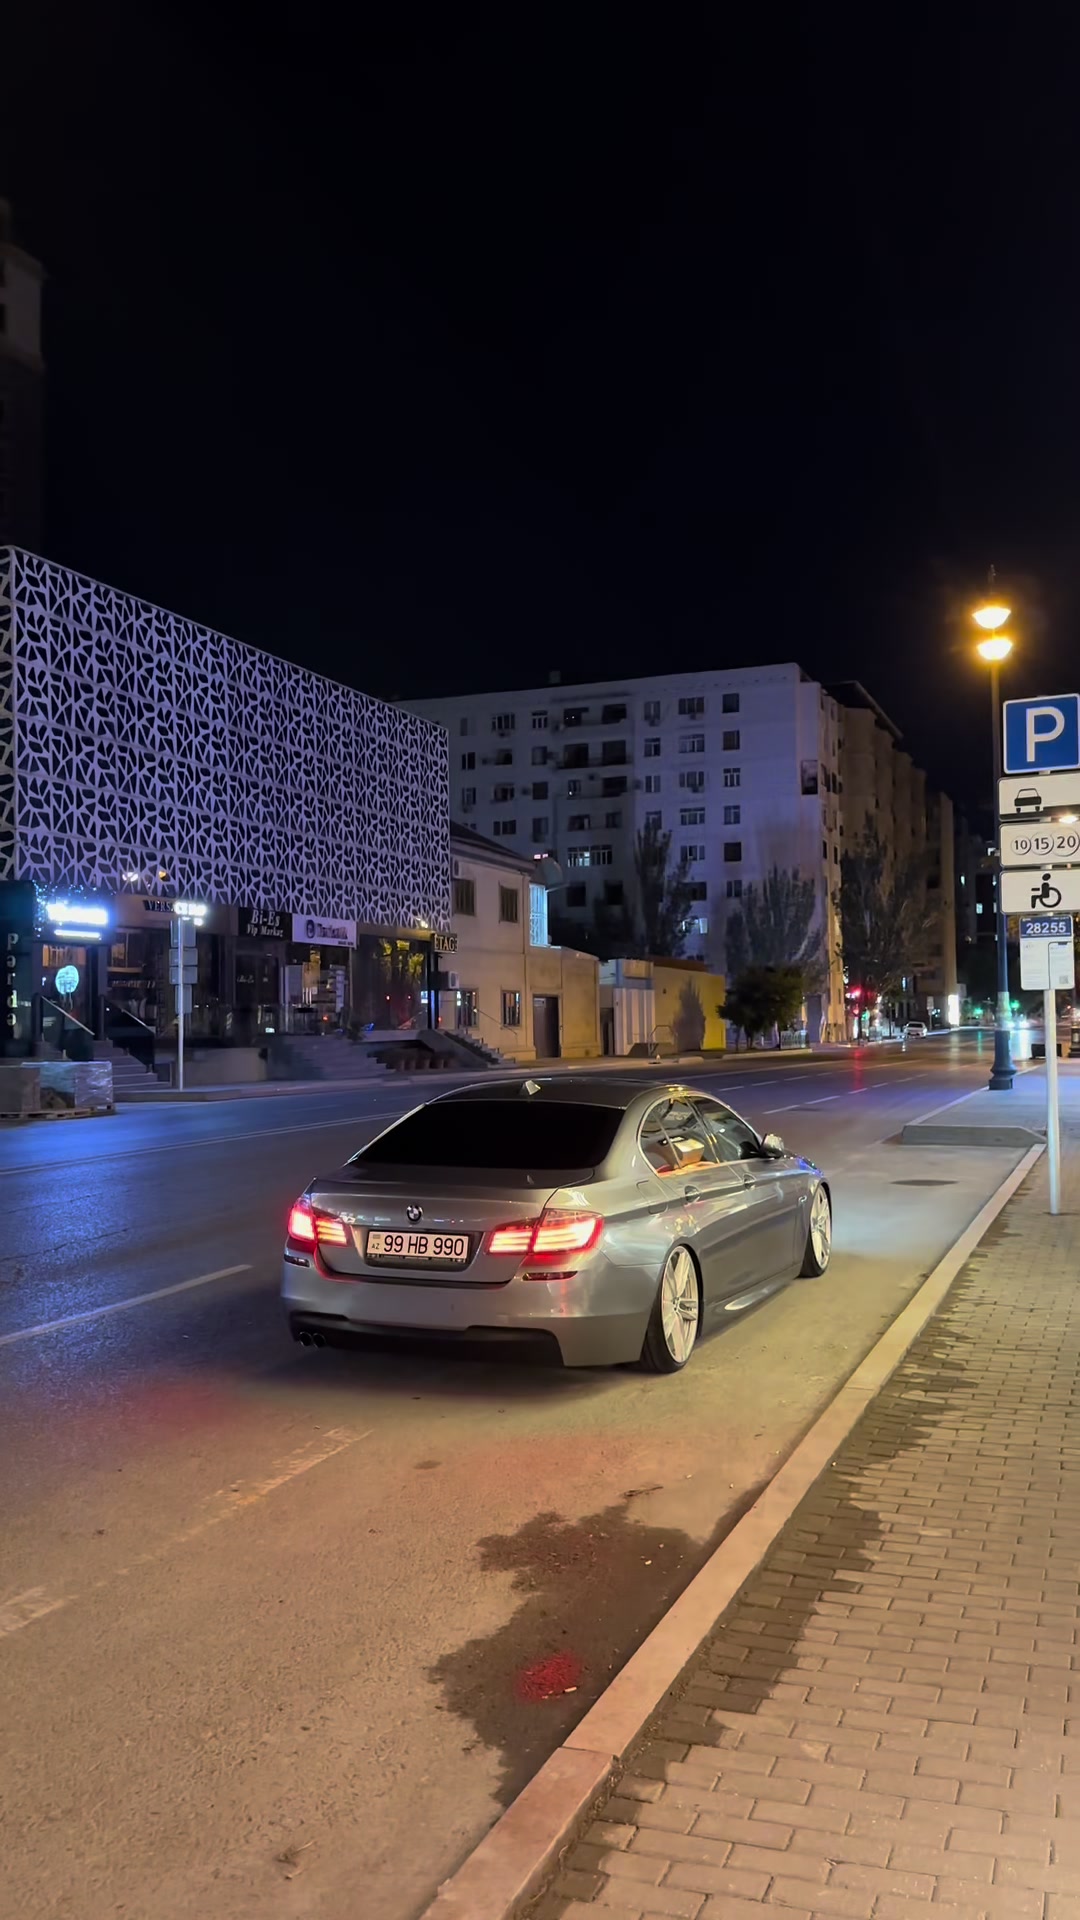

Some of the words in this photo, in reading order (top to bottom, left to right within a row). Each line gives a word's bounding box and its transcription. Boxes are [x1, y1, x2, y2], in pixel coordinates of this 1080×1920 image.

[1026, 706, 1065, 762] P
[1014, 839, 1028, 850] 10
[1034, 837, 1049, 850] 15
[1056, 835, 1076, 849] 20
[251, 909, 280, 927] Bi-Es
[1026, 922, 1067, 934] 28255
[384, 1235, 404, 1252] 99
[407, 1236, 428, 1254] HB
[433, 1238, 464, 1256] 990
